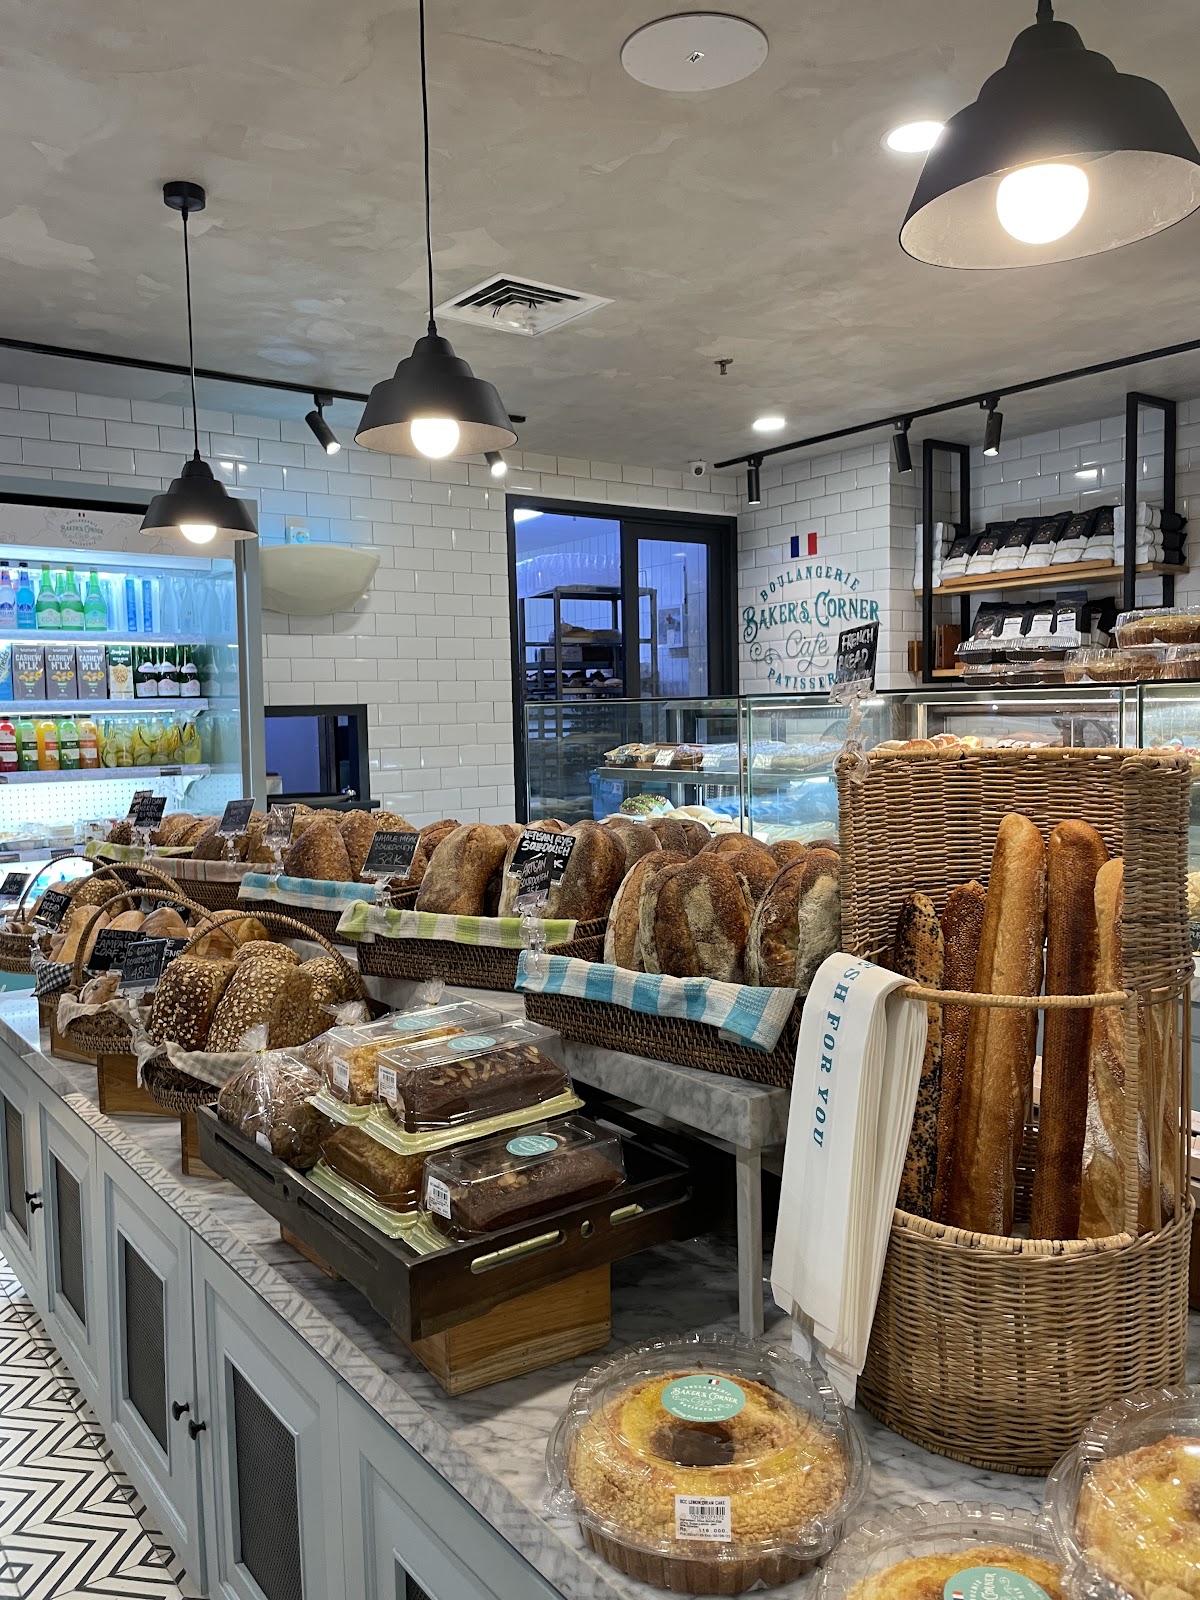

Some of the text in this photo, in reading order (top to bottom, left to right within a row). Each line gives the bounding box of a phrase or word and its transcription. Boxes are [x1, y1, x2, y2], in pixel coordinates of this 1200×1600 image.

[760, 566, 860, 602] BOULANGERIE
[742, 589, 881, 643] BAKER'S CORNER
[842, 627, 874, 652] FRENCH
[15, 654, 42, 662] CASHEW
[47, 654, 73, 662] CASHEW
[79, 655, 103, 663] CASHEW
[767, 667, 837, 690] PATISSER
[374, 834, 398, 842] WHOLE
[100, 930, 138, 940] RAISIN
[94, 948, 119, 958] LOAF
[820, 1011, 841, 1074] FOR
[813, 1086, 829, 1148] YOU
[709, 1391, 738, 1404] CORNER
